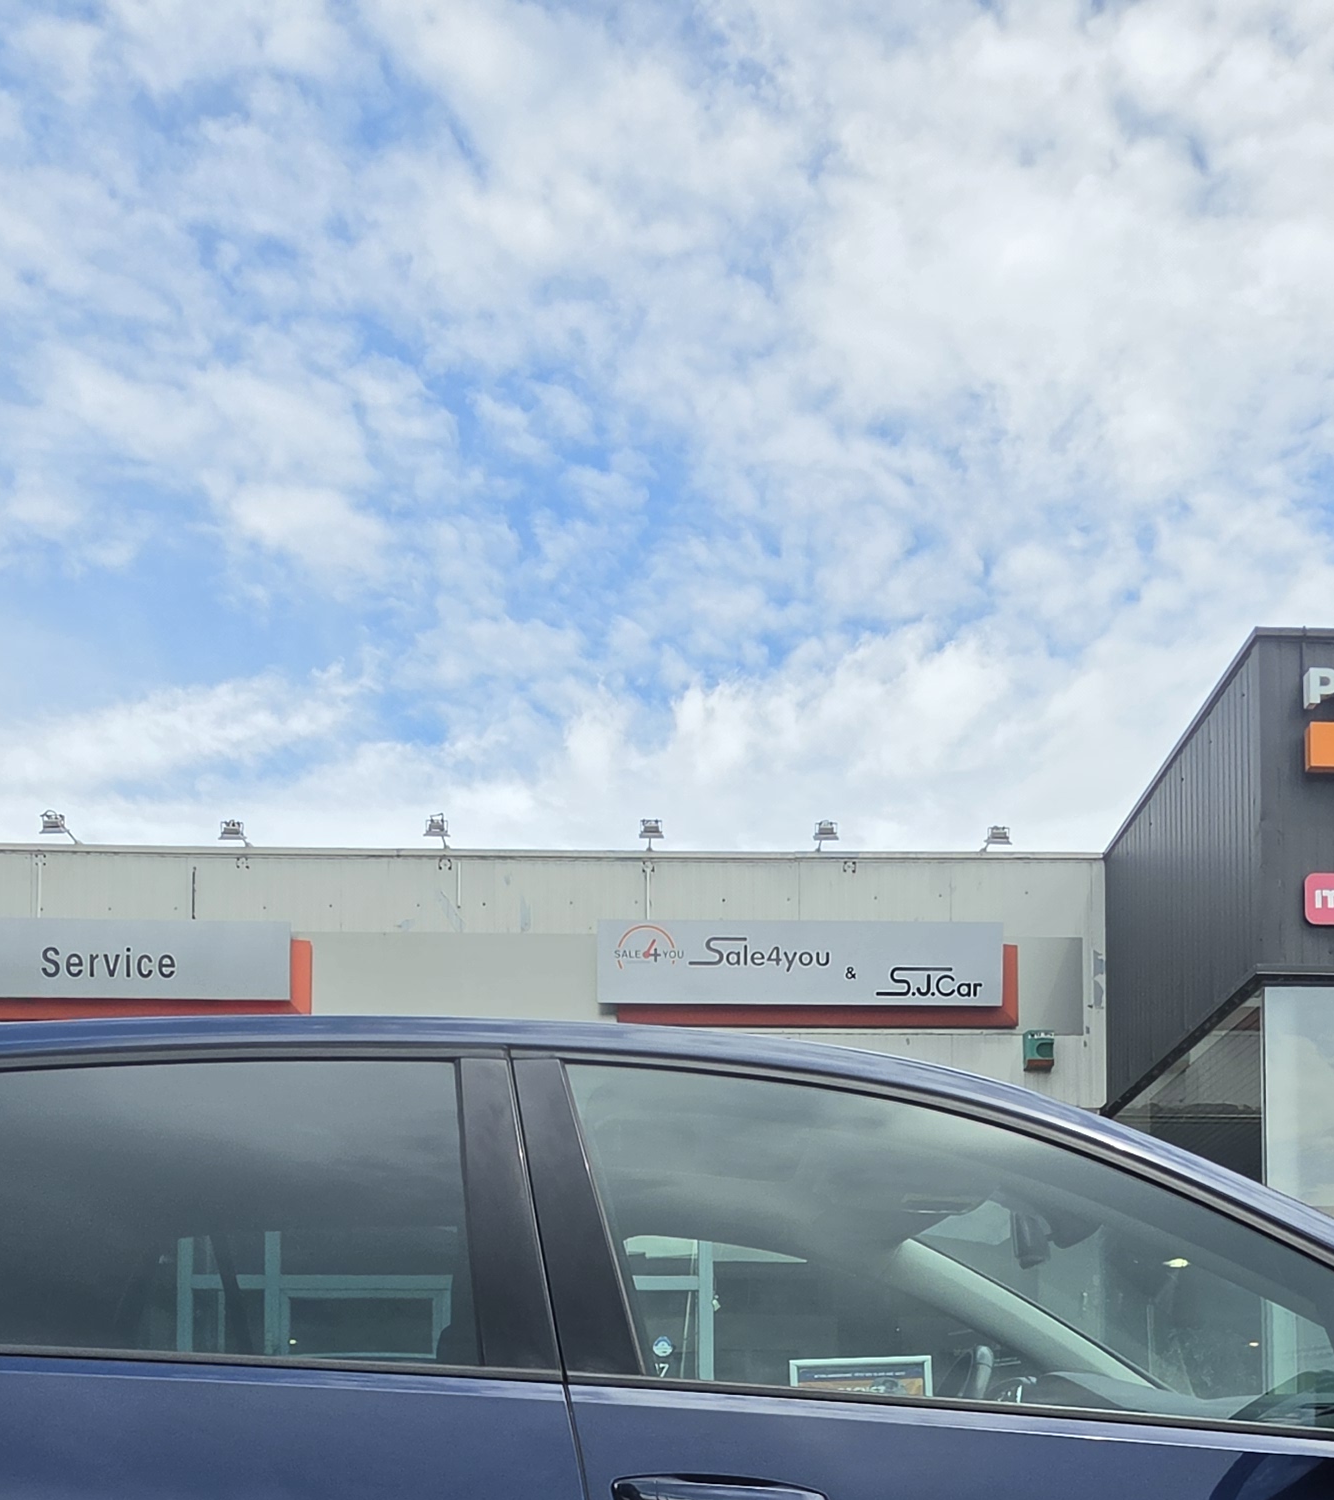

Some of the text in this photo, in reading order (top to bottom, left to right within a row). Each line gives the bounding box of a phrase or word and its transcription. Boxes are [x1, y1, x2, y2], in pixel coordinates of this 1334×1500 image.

[40, 946, 177, 979] Service
[688, 936, 831, 972] Sale4you
[844, 966, 856, 980] &
